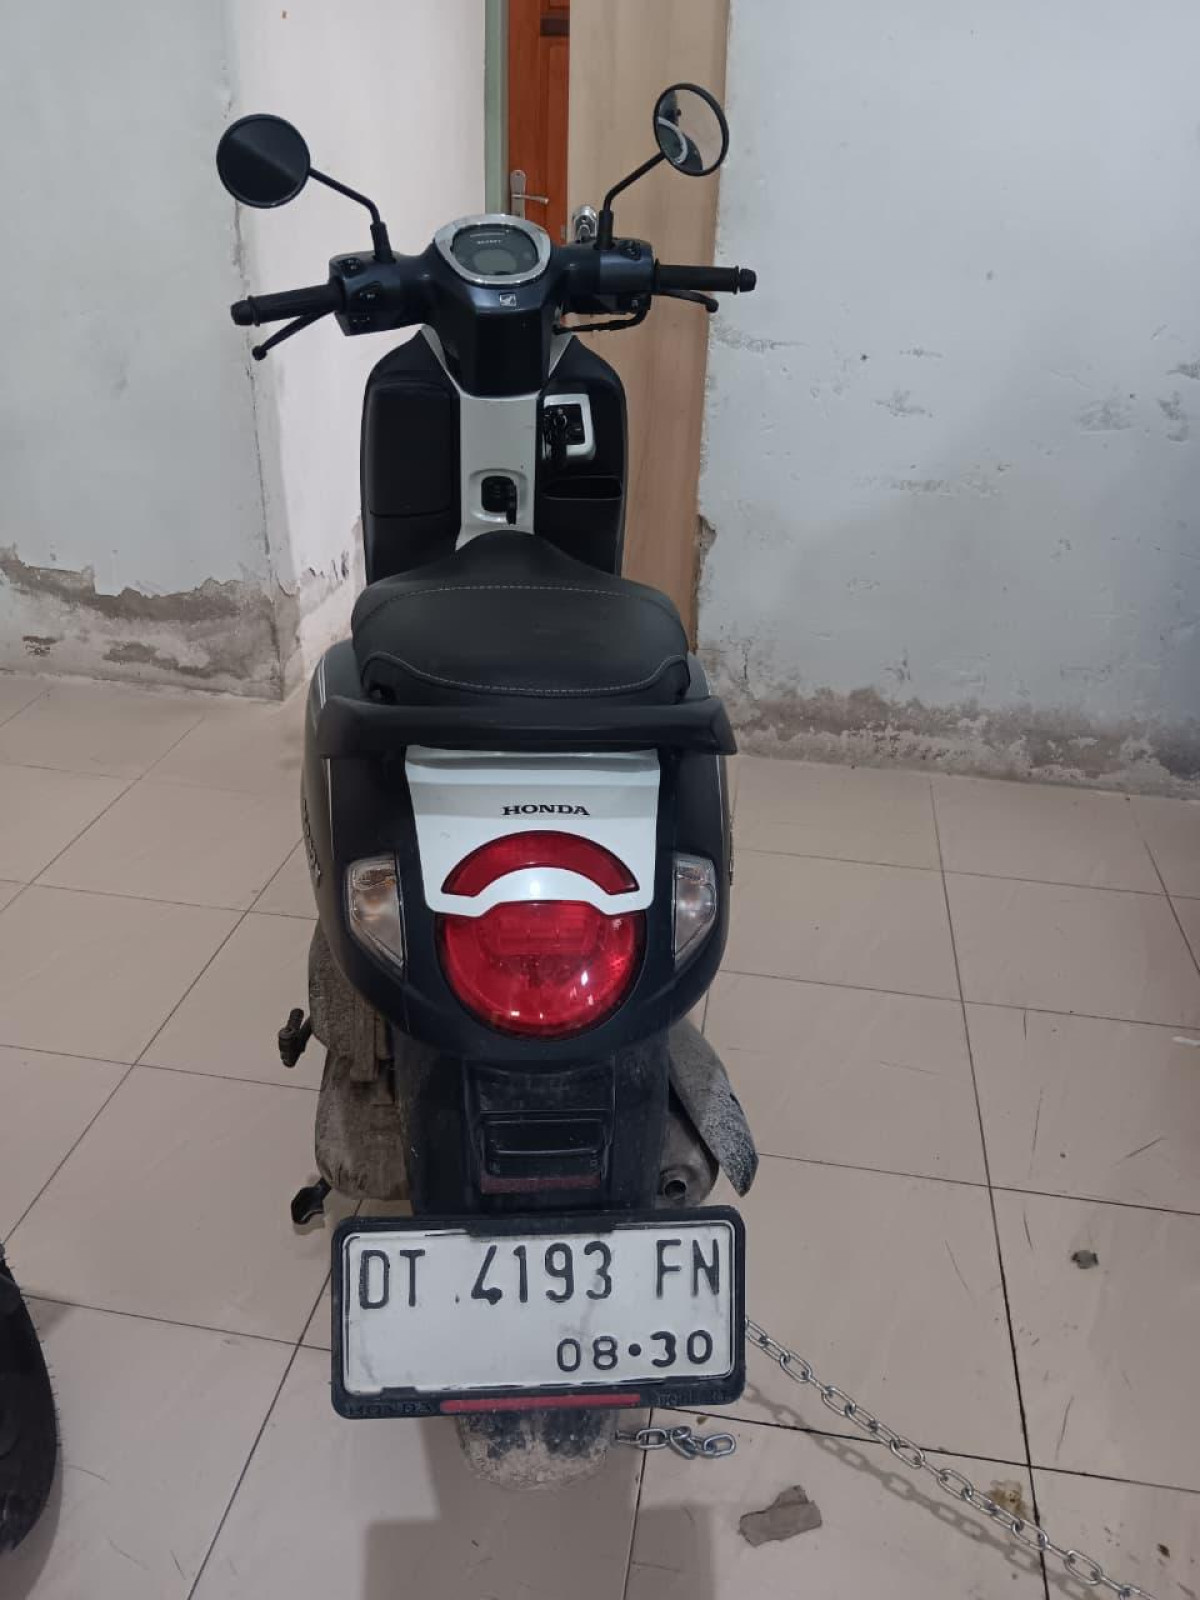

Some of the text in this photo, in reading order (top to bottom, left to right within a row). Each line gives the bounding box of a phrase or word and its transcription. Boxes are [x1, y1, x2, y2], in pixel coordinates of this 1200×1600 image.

[502, 804, 591, 816] HONDA
[359, 1239, 720, 1310] DT 4193 FN
